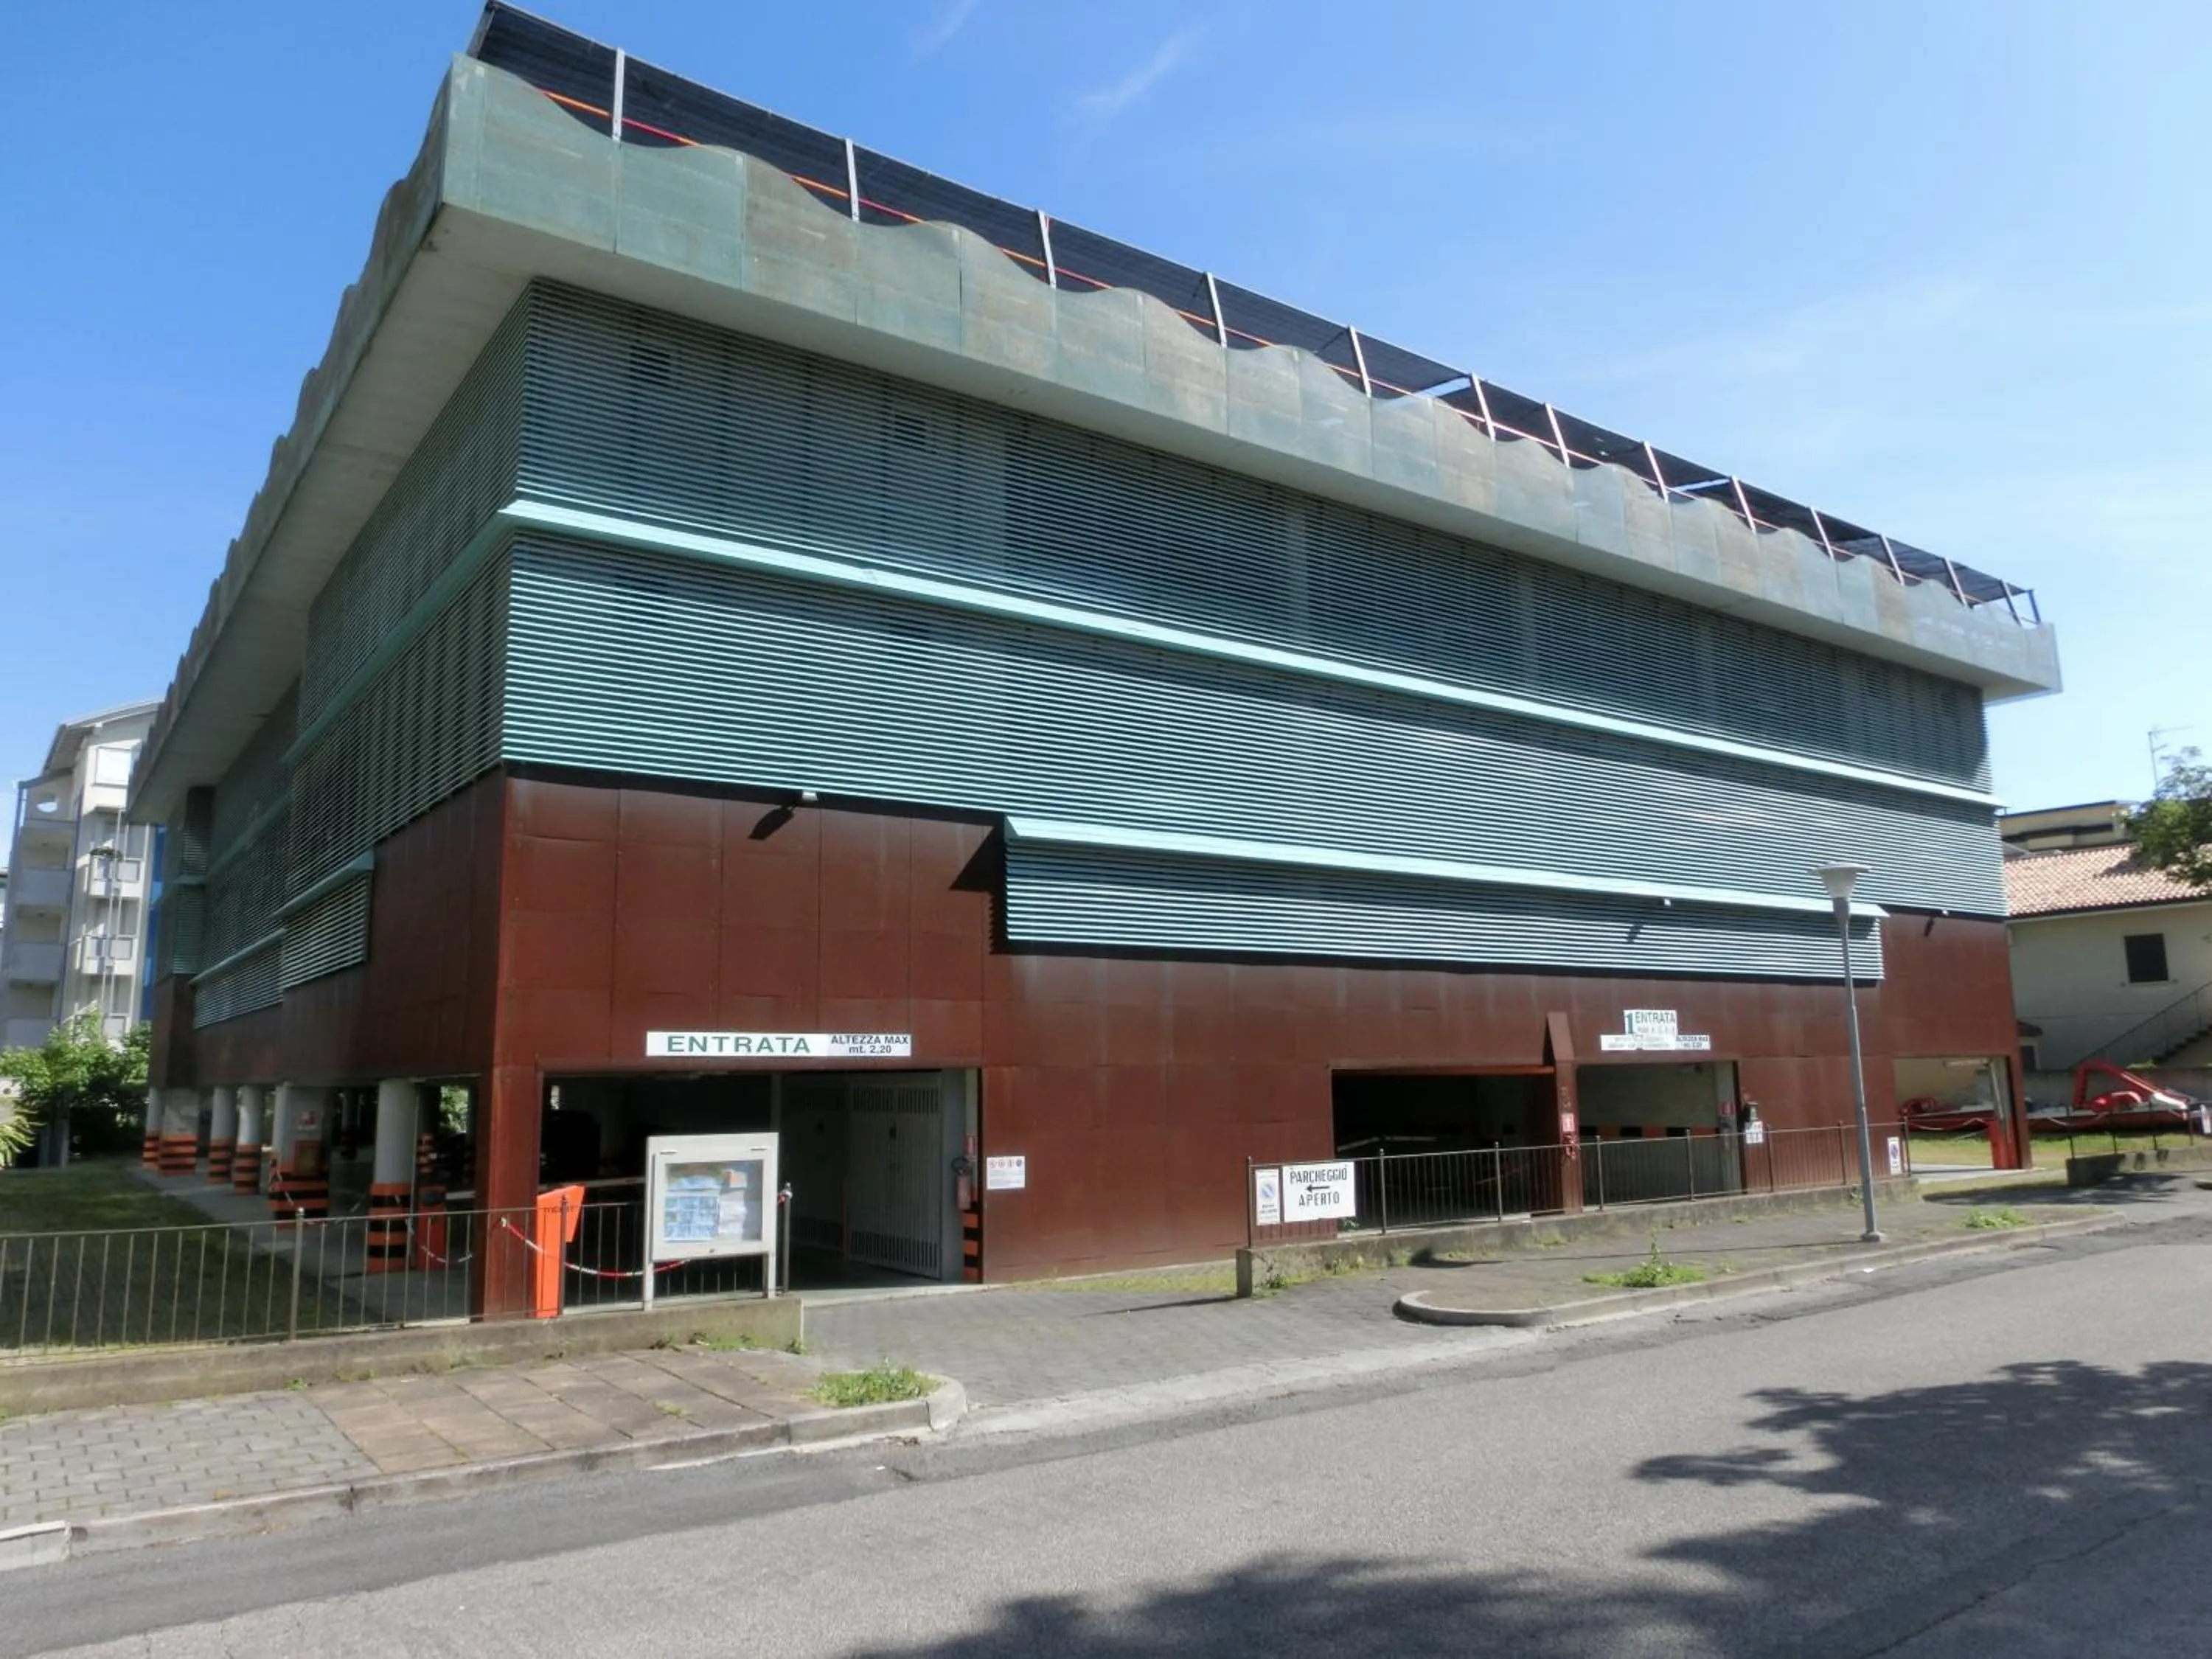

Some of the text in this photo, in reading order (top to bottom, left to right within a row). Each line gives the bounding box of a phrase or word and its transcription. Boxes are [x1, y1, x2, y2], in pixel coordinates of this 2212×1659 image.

[1635, 1011, 1676, 1023] ENTRATA
[667, 1035, 811, 1054] ENTRATA
[831, 1034, 909, 1045] ALTEZZA MAX
[1289, 1167, 1348, 1185] PARCHEGGIO
[1298, 1191, 1340, 1207] APERTO
